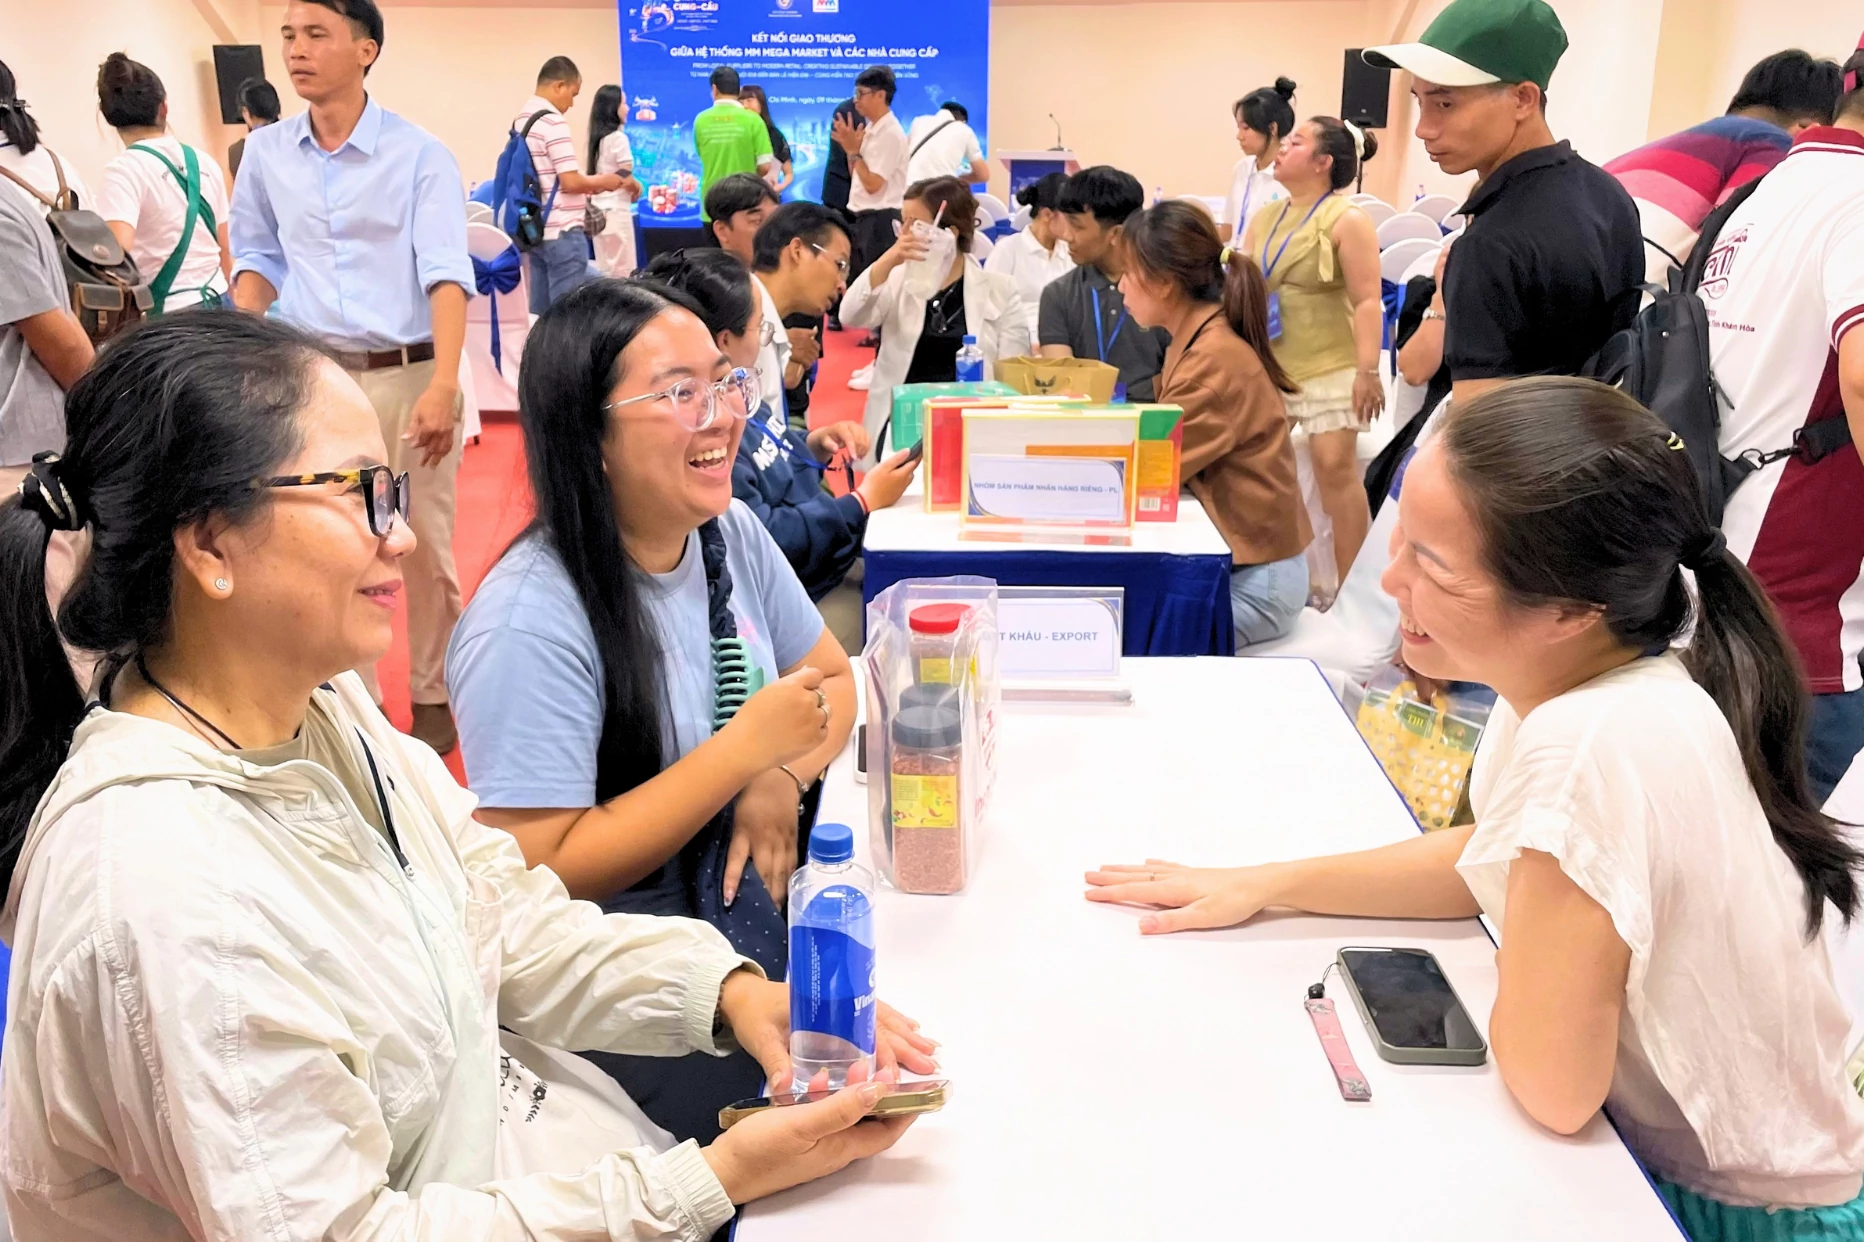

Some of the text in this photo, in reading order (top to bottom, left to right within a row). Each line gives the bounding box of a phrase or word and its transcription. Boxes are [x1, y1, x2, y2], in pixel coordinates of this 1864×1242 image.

[751, 31, 769, 43] KẾT
[770, 31, 789, 43] NỐI
[789, 34, 815, 43] GIAO
[670, 45, 939, 59] GIỮA HỆ THỐNG MM MEGA MARKET VÀ CÁC NHÀ CUNG CẤP
[996, 482, 1013, 490] SẢN
[1009, 629, 1041, 641] KHẨU
[1052, 631, 1098, 641] EXPORT
